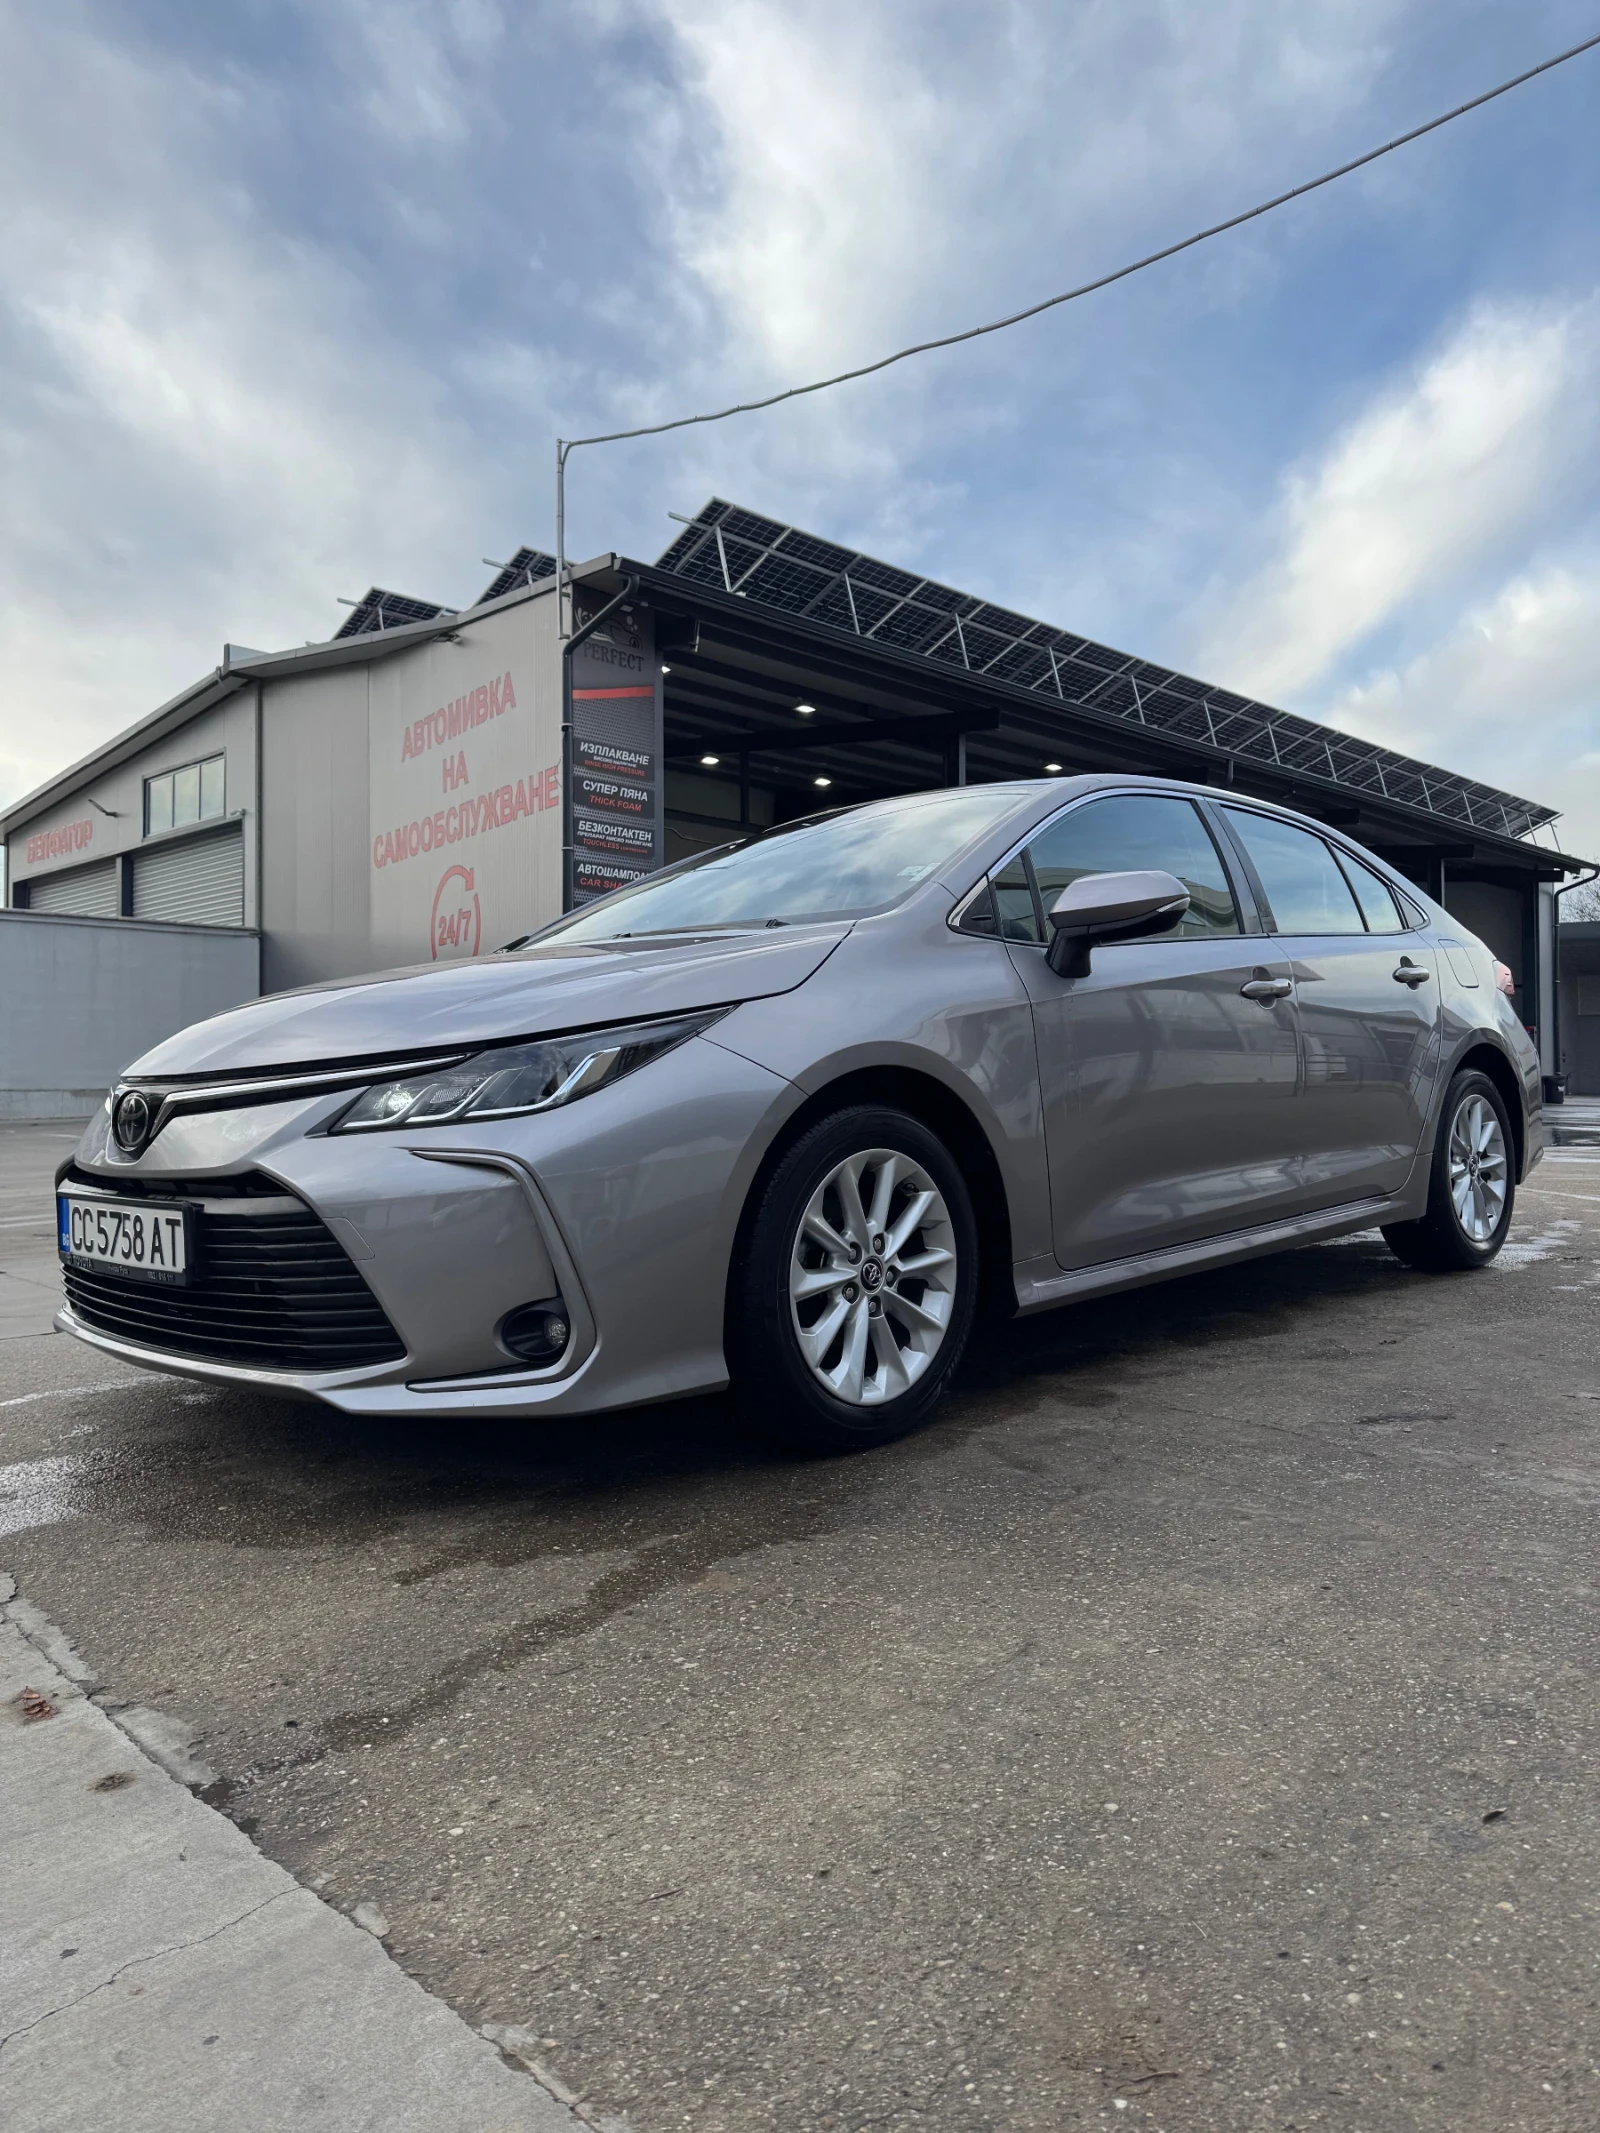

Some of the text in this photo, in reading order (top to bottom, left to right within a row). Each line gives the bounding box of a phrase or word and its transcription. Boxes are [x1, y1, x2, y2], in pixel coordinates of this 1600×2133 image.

[583, 641, 645, 672] PERFECT
[401, 672, 516, 763] АВТОМИВКА
[580, 741, 650, 766] ИЗПЛАКВАНЕ
[442, 751, 469, 793] НА
[584, 760, 646, 777] RINSE HIGH PRESSURE
[583, 780, 648, 802] СУПЕР ПЯНА
[589, 795, 642, 812] THICK FOAM
[373, 765, 560, 868] САМООБСЛУЖВАНЕ
[578, 820, 652, 842] БЕЗКОНТАКТЕН
[583, 838, 620, 850] TOUCHLESS
[579, 877, 601, 888] CAR
[438, 909, 471, 948] 24/7
[62, 1233, 70, 1247] BG
